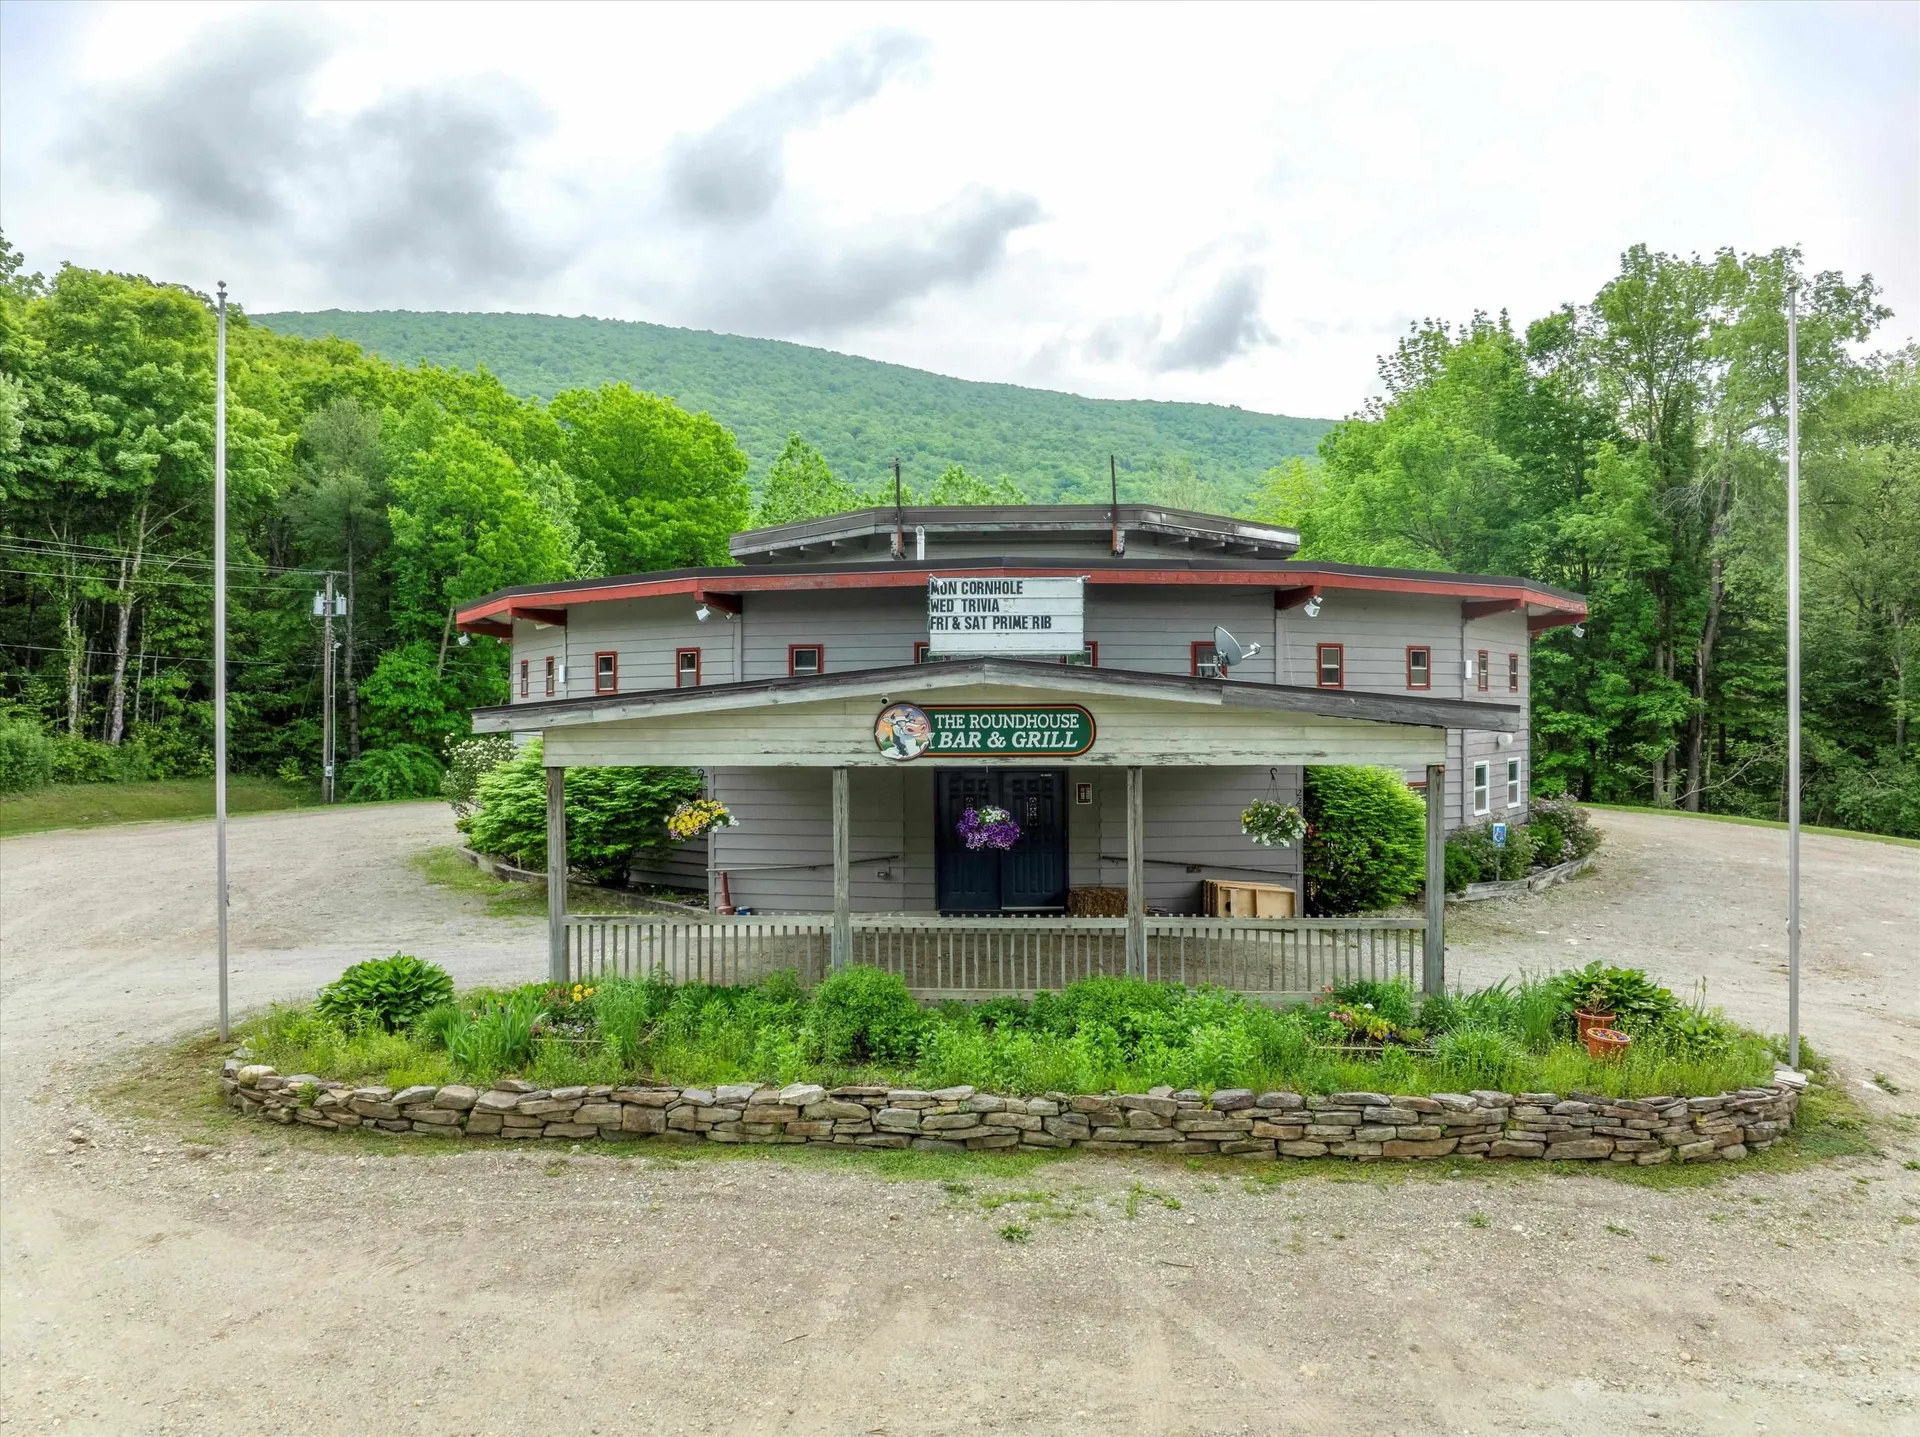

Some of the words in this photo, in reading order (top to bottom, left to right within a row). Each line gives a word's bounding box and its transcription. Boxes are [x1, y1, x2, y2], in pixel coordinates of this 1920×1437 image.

[961, 581, 1023, 595] CORNHOLE
[930, 598, 954, 612] WED
[961, 598, 1000, 612] TRIVIA
[930, 616, 949, 630] FRI
[952, 616, 961, 630] &
[965, 616, 987, 630] SAT
[993, 616, 1028, 630] PRIME
[1032, 616, 1052, 630] RIB
[934, 713, 966, 729] THE
[969, 713, 1080, 729] ROUNDHOUSE
[938, 731, 982, 749] BAR
[987, 731, 1007, 749] &
[1011, 730, 1079, 749] GRILL
